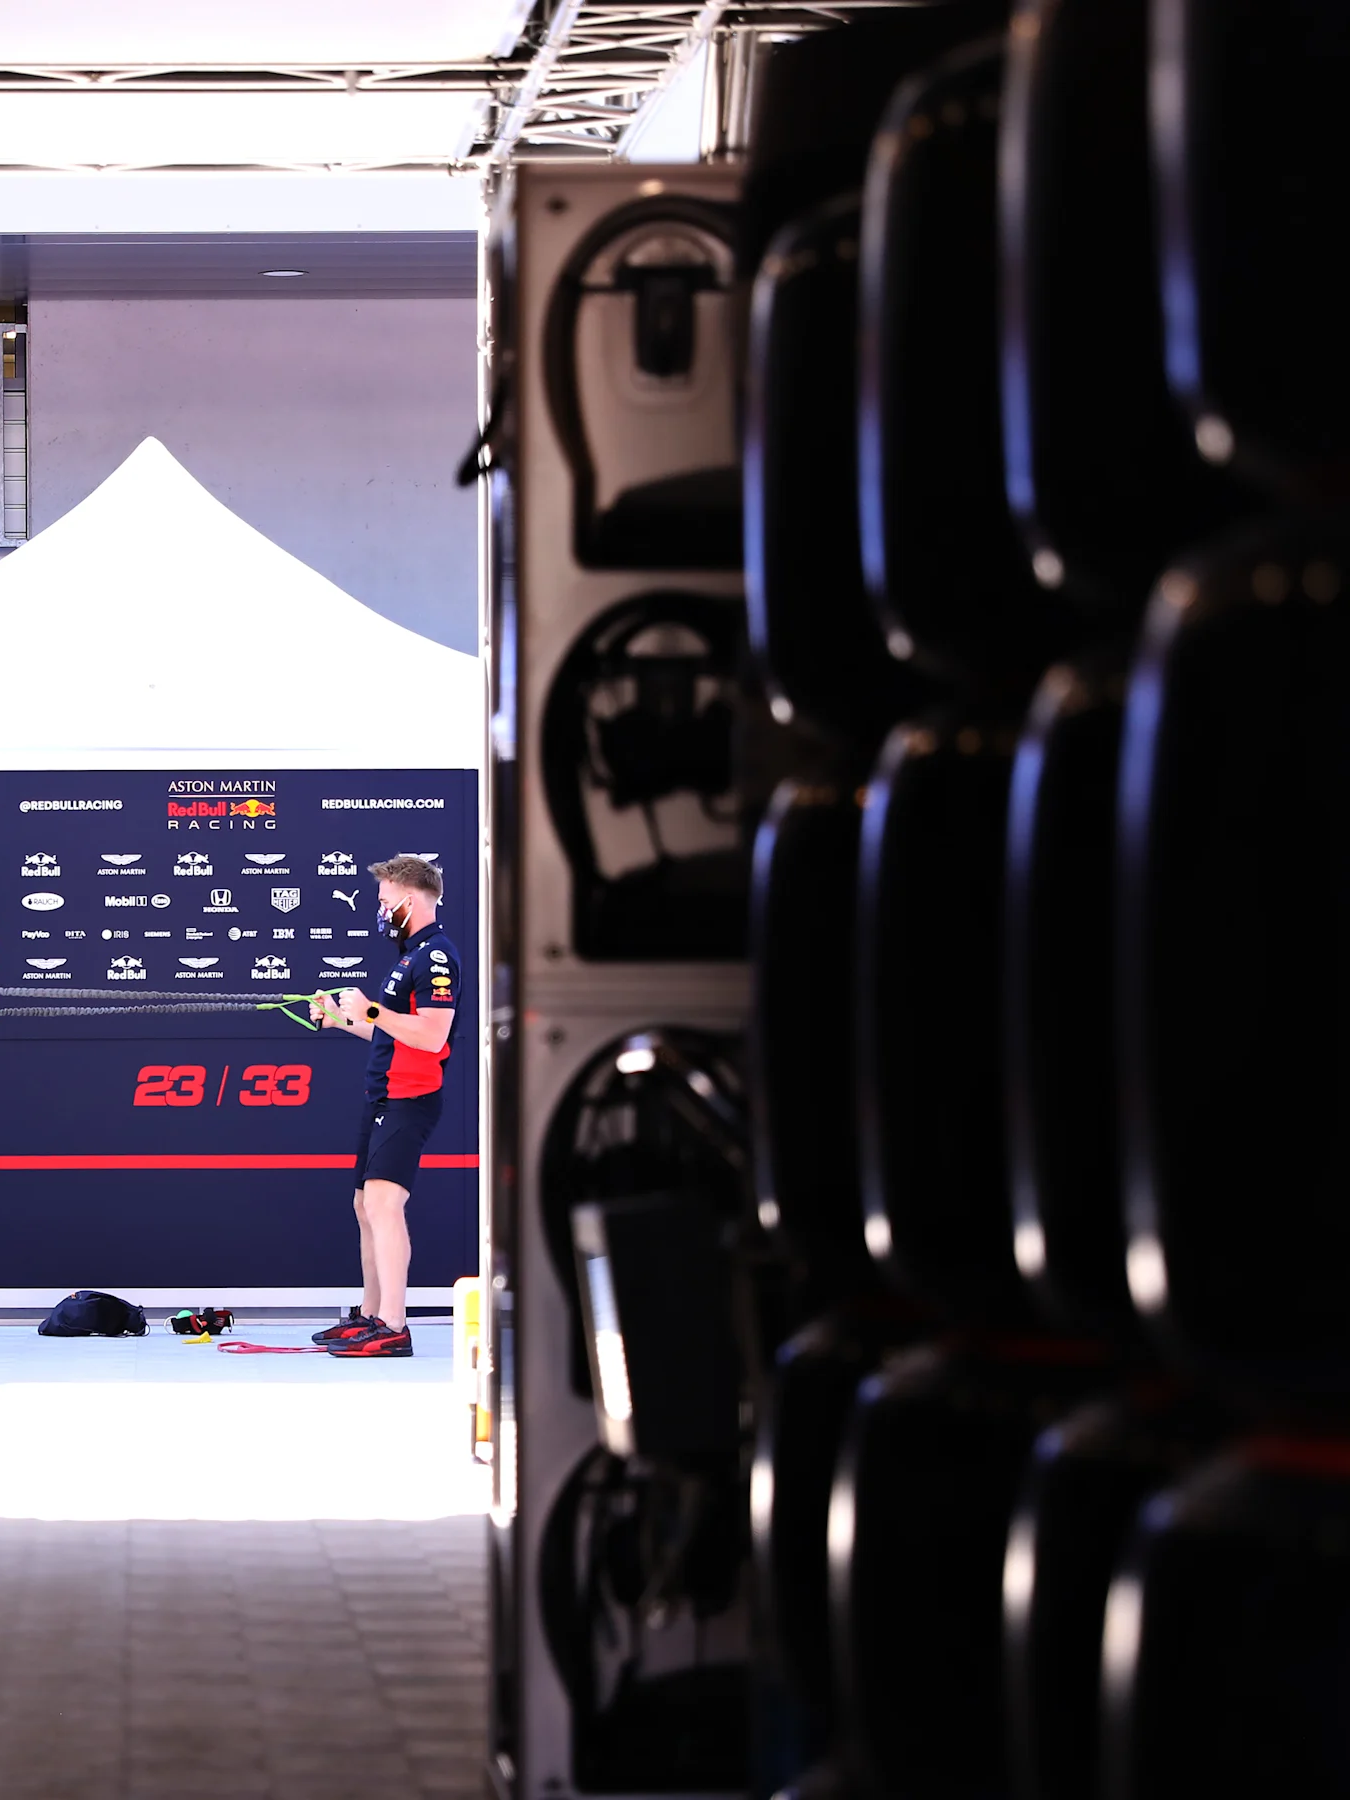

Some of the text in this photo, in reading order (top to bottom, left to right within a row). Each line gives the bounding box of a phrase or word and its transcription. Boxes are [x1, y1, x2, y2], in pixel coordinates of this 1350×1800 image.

[167, 780, 276, 793] ASTON MARTIN
[19, 799, 123, 812] @REDBULLRACING
[321, 798, 445, 810] REDBULLRACING.COM
[167, 819, 276, 830] RACING
[273, 889, 298, 898] TAG
[104, 895, 136, 907] Mobil
[272, 898, 299, 911] HEUER
[202, 906, 240, 914] HONDA
[113, 930, 130, 939] IRIS
[272, 928, 295, 939] IBM
[133, 1065, 207, 1107] 23
[239, 1064, 313, 1107] 33
